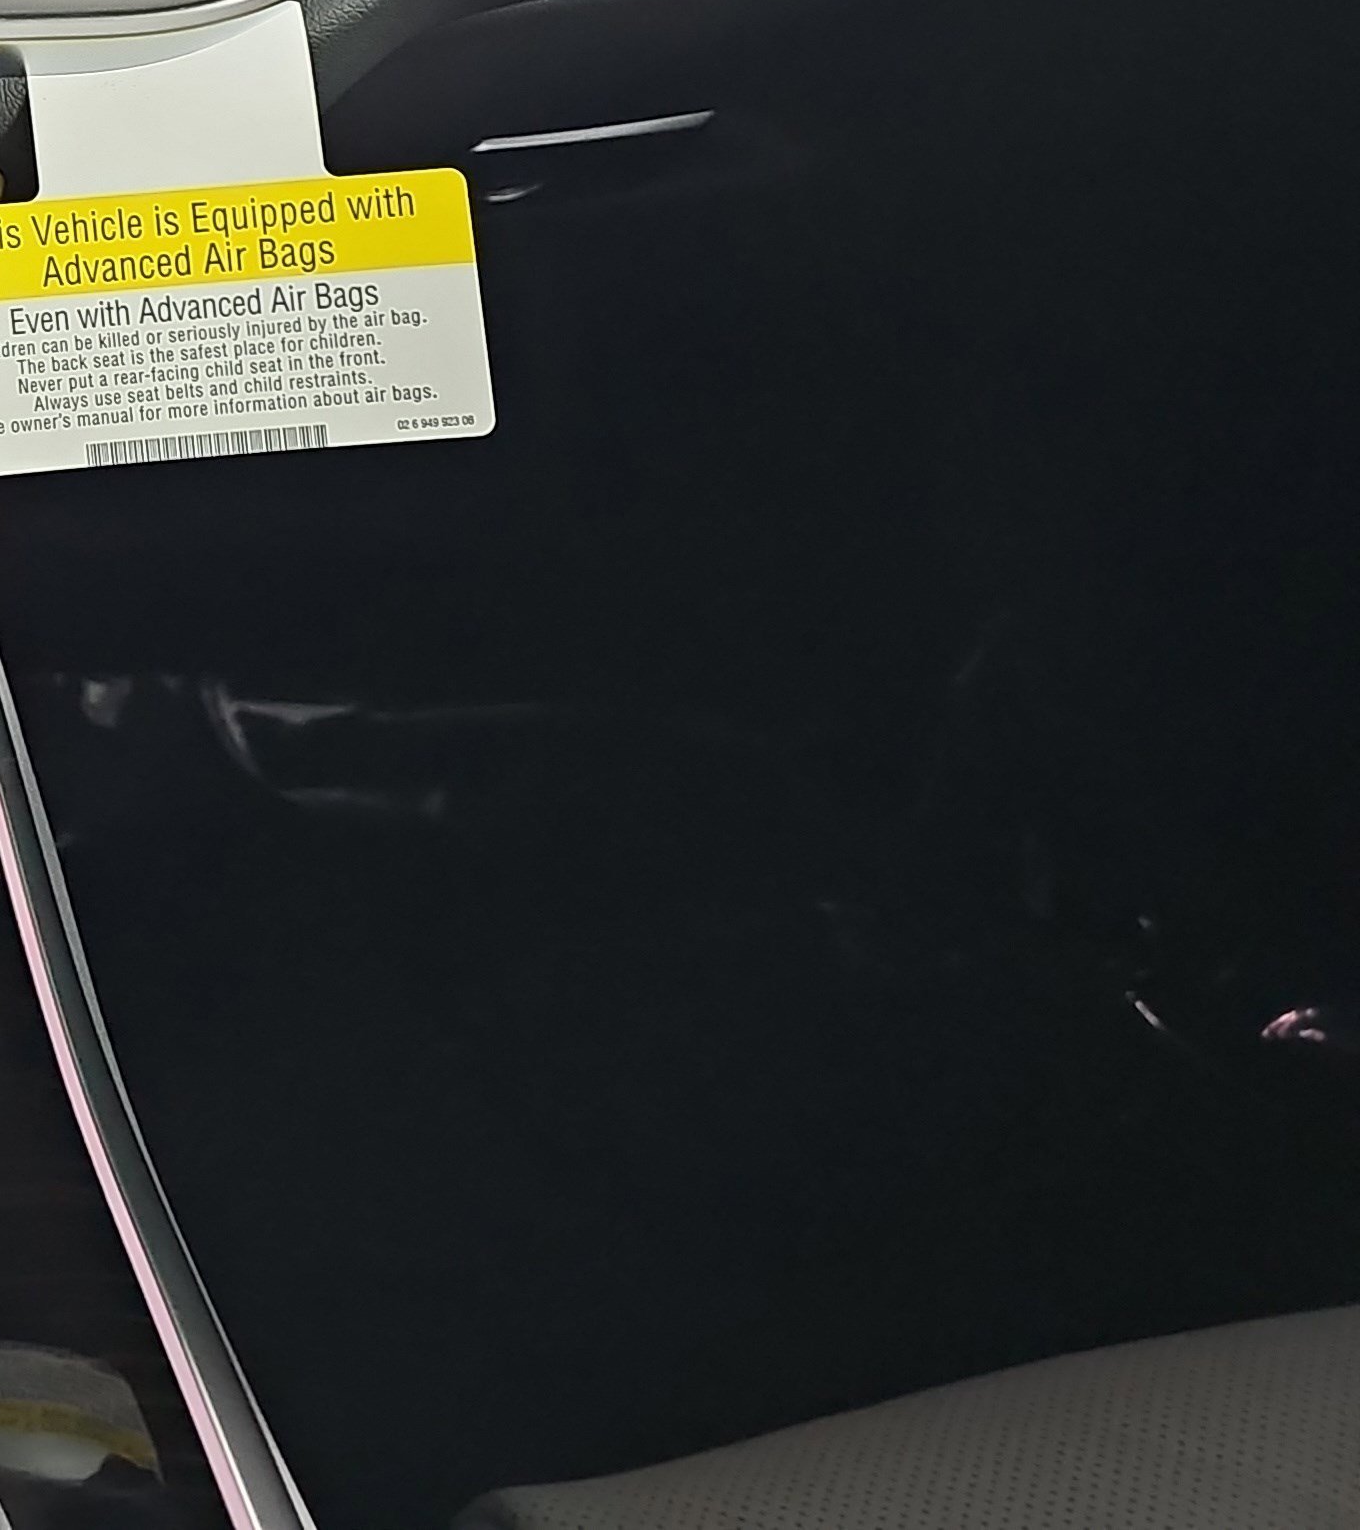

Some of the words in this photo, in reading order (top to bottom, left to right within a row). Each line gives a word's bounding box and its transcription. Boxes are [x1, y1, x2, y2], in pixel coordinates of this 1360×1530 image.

[31, 208, 142, 246] Vehicle
[154, 205, 180, 237] is
[191, 191, 335, 238] Equipped
[346, 186, 415, 221] with
[43, 244, 191, 287] Advanced
[204, 241, 247, 274] Air
[259, 238, 335, 273] Bags
[10, 307, 70, 336] Even
[77, 299, 131, 329] with
[139, 287, 262, 324] Advanced
[271, 286, 307, 313] Air
[315, 282, 379, 312] Bags
[42, 338, 69, 355] can
[74, 335, 93, 351] be
[98, 330, 140, 349] killed
[146, 330, 163, 345] or
[168, 323, 240, 344] seriously
[246, 317, 302, 339] injured
[308, 315, 327, 334] by
[332, 313, 361, 330] the
[364, 311, 385, 328] air
[391, 309, 428, 327] bag.
[17, 358, 46, 375] The
[51, 354, 88, 373] back
[93, 351, 126, 369] seat
[131, 348, 145, 366] is
[150, 346, 175, 364] the
[180, 341, 228, 362] safest
[234, 338, 275, 359] place
[281, 336, 304, 353] for
[310, 331, 382, 351] children.
[18, 377, 63, 395] Never
[69, 372, 95, 393] put
[99, 373, 109, 388] a
[114, 365, 200, 386] rear-facing
[206, 357, 244, 378] child
[250, 355, 283, 374] seat
[288, 353, 303, 372] in
[309, 350, 334, 369] the
[339, 348, 386, 367] front.
[11, 413, 72, 434] owner's
[77, 407, 134, 427] manual
[139, 404, 163, 421] for
[168, 401, 208, 419] more
[214, 392, 308, 416] information
[313, 388, 360, 408] about
[365, 386, 387, 403] air
[392, 384, 438, 403] bags.
[34, 392, 89, 412] Always
[95, 390, 122, 407] use
[127, 386, 160, 404] seat
[166, 382, 204, 401] belts
[210, 379, 238, 397] and
[244, 375, 282, 394] child
[289, 370, 373, 390] restraints.
